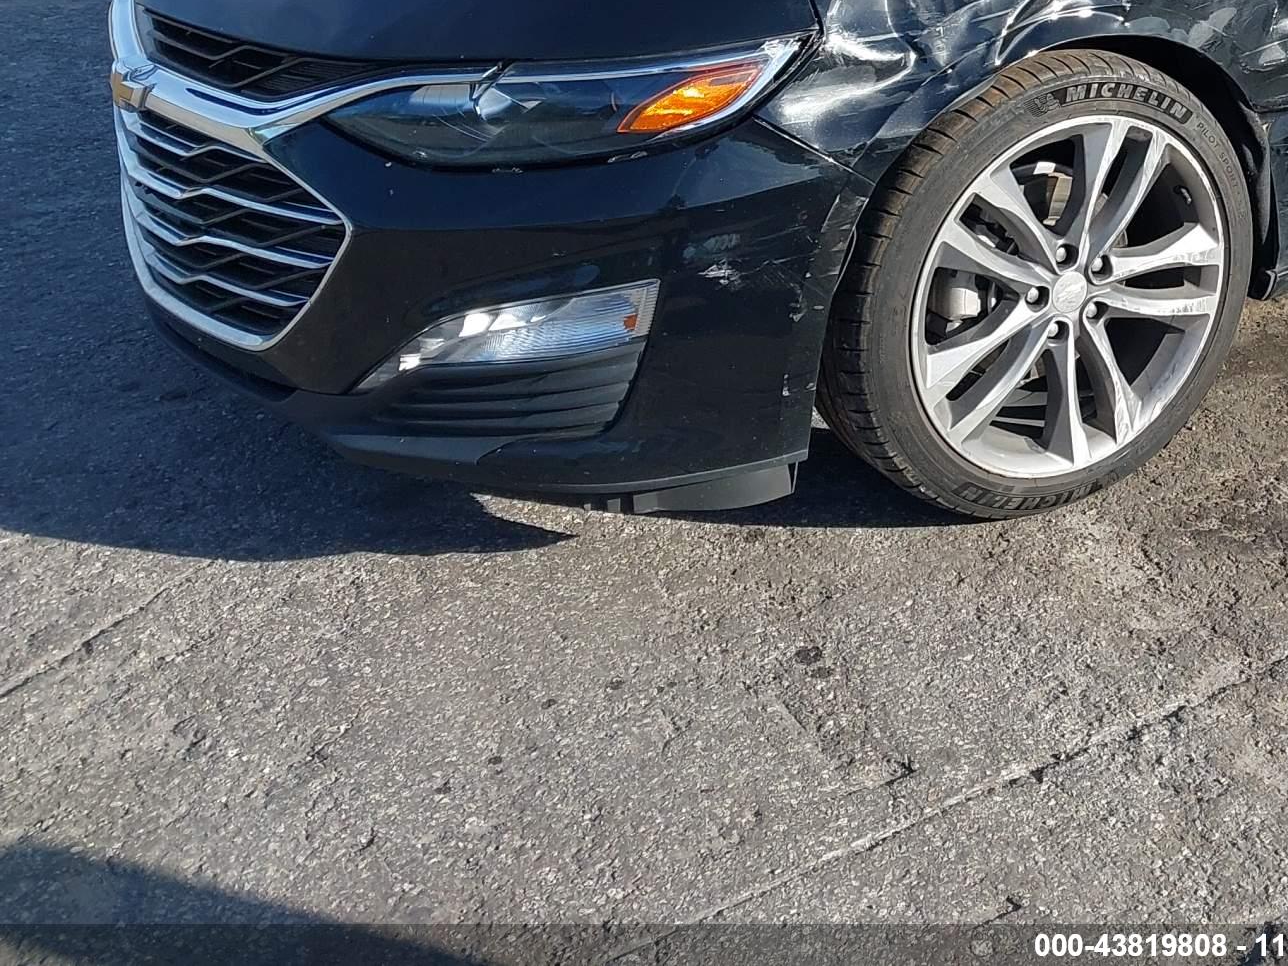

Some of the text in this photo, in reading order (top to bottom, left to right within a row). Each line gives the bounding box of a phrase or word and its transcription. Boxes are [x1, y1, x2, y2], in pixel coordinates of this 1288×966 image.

[1065, 82, 1240, 188] MICHELIN PILOT SPORT
